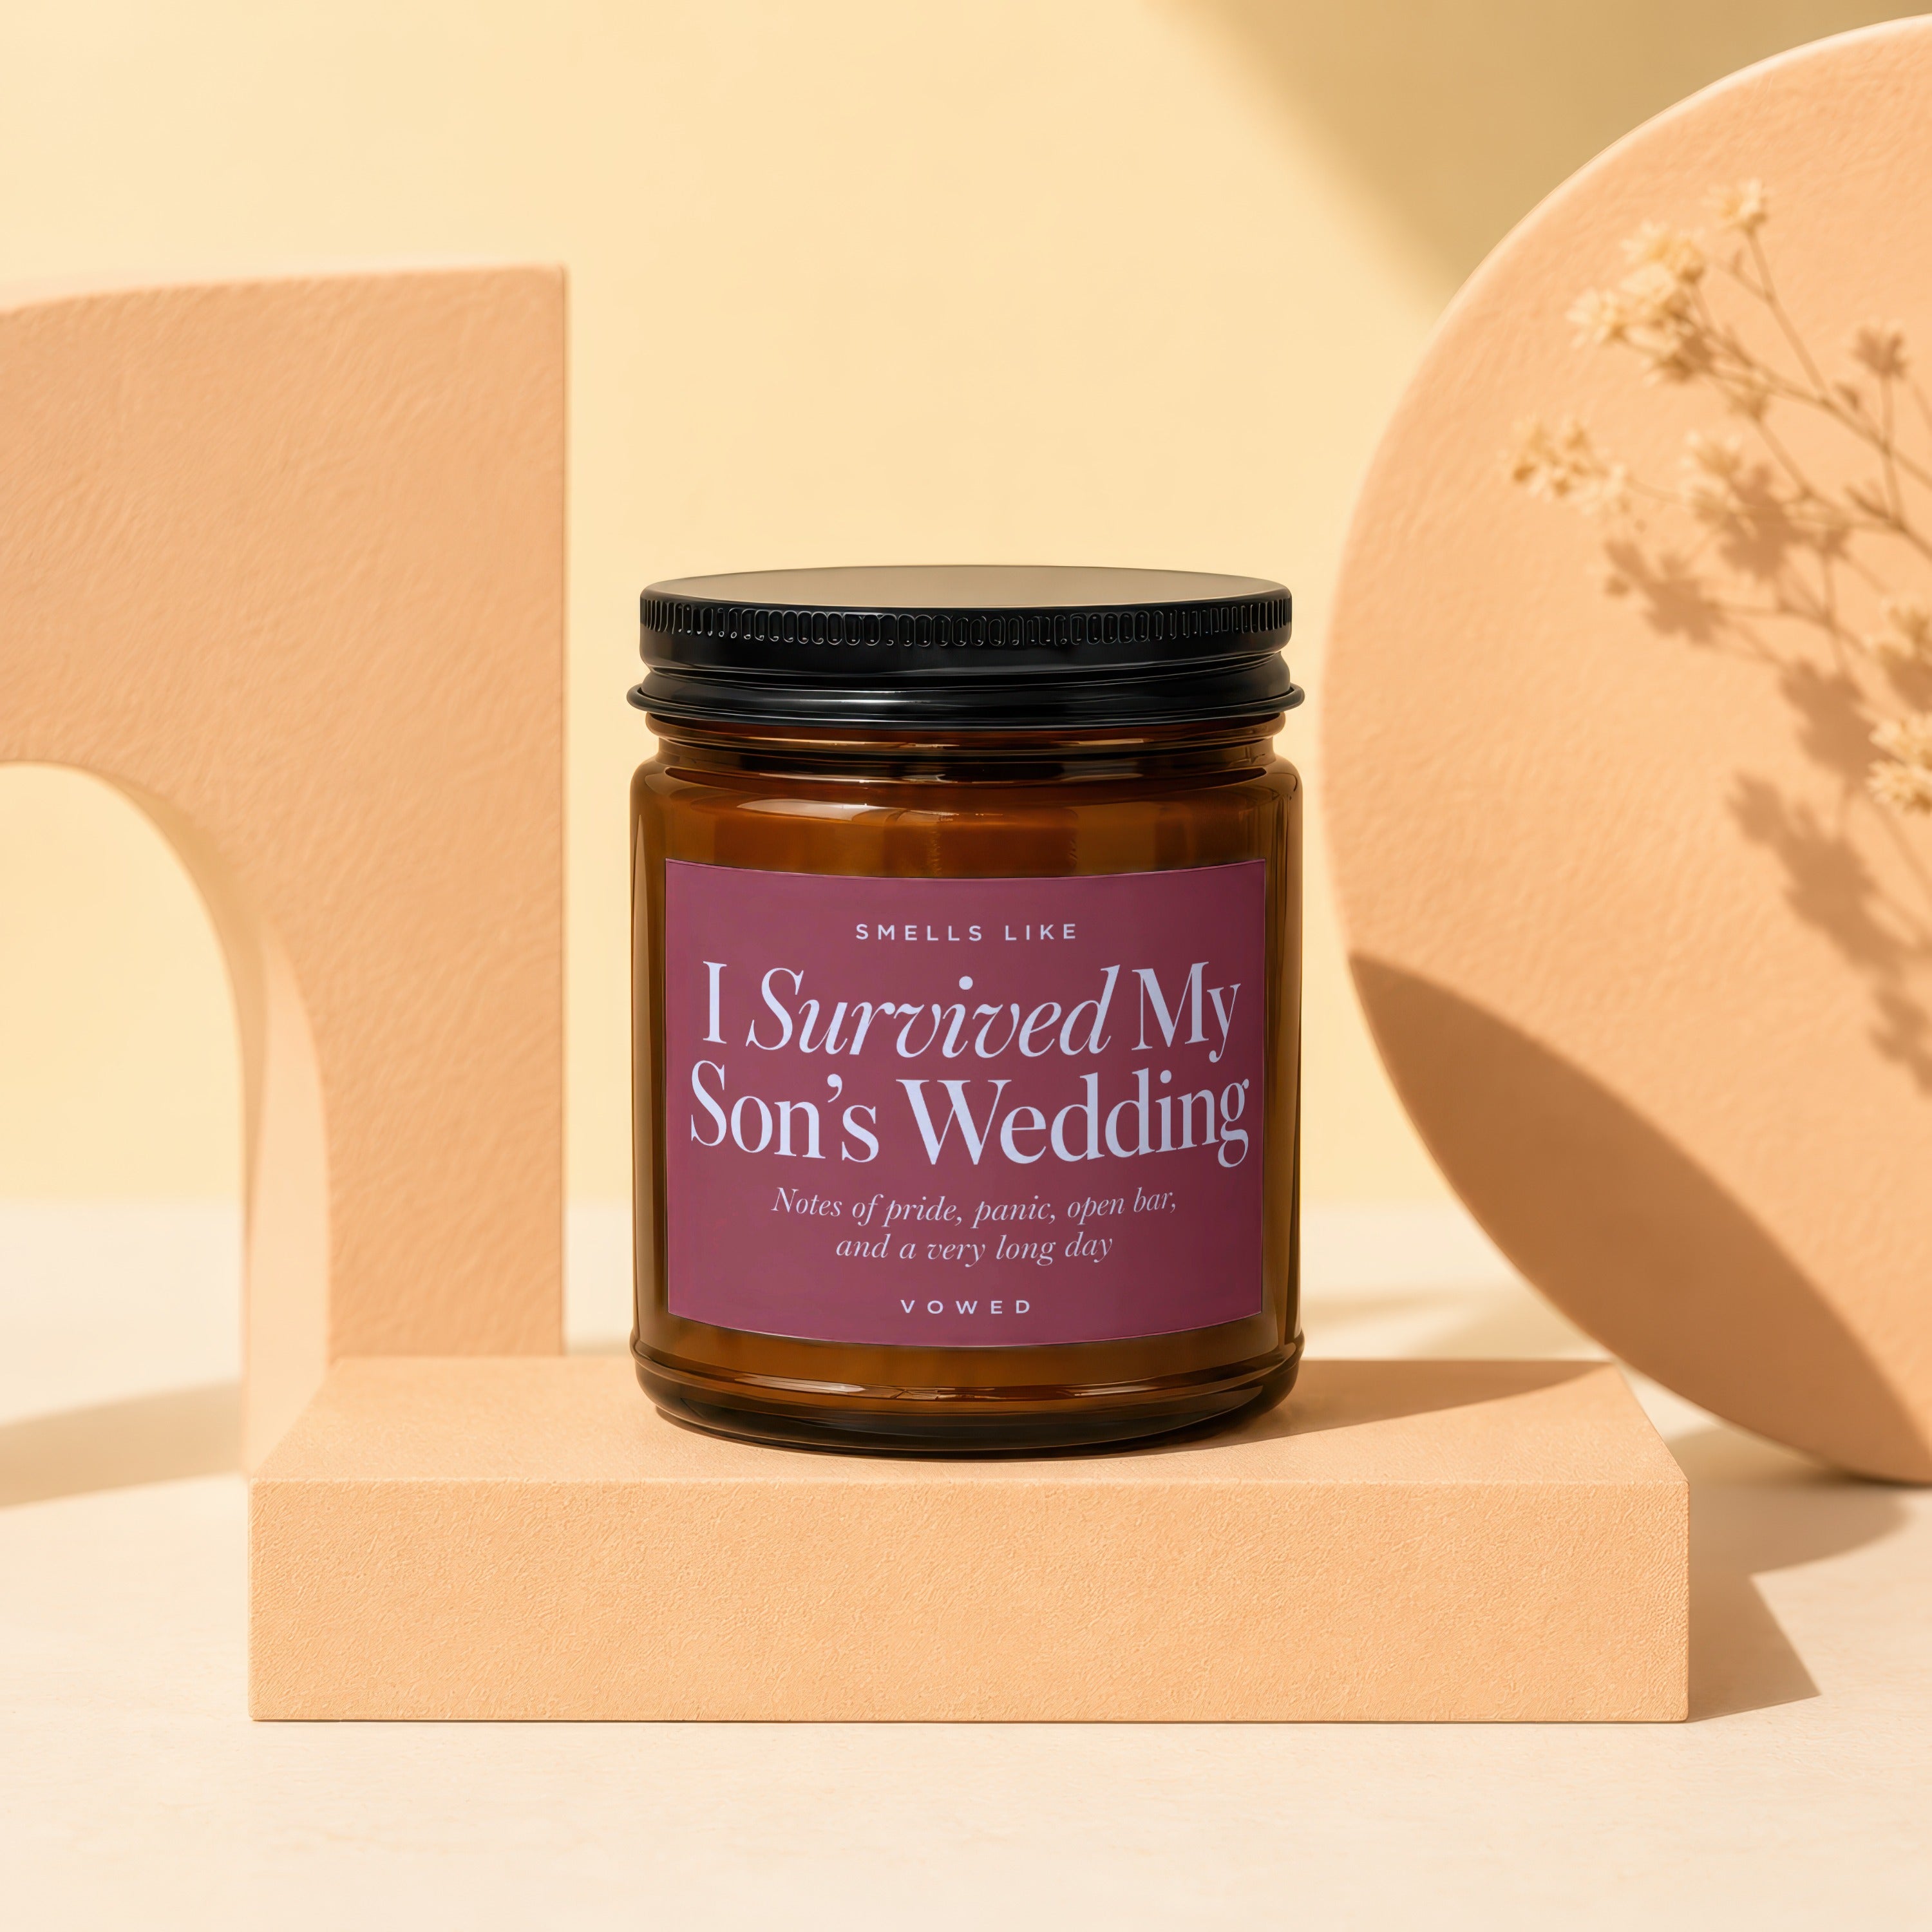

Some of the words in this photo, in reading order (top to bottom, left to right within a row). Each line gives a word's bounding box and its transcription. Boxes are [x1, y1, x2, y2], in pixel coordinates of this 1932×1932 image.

[856, 923, 982, 942] SMELLS
[1005, 923, 1077, 941] LIKE
[703, 961, 727, 1045] I
[745, 965, 1121, 1059] Survived
[1132, 961, 1241, 1063] My
[691, 1060, 879, 1164] Son’s
[896, 1068, 1249, 1168] Wedding
[771, 1187, 842, 1217] Notes
[852, 1195, 884, 1226] of
[883, 1195, 963, 1227] pride,
[971, 1195, 1056, 1229] panic,
[1066, 1197, 1125, 1225] open
[1133, 1187, 1177, 1213] bar,
[836, 1233, 891, 1258] and
[899, 1244, 916, 1259] a
[927, 1244, 987, 1268] very
[996, 1235, 1055, 1266] long
[1065, 1231, 1113, 1263] day
[900, 1300, 1031, 1314] VOWED
